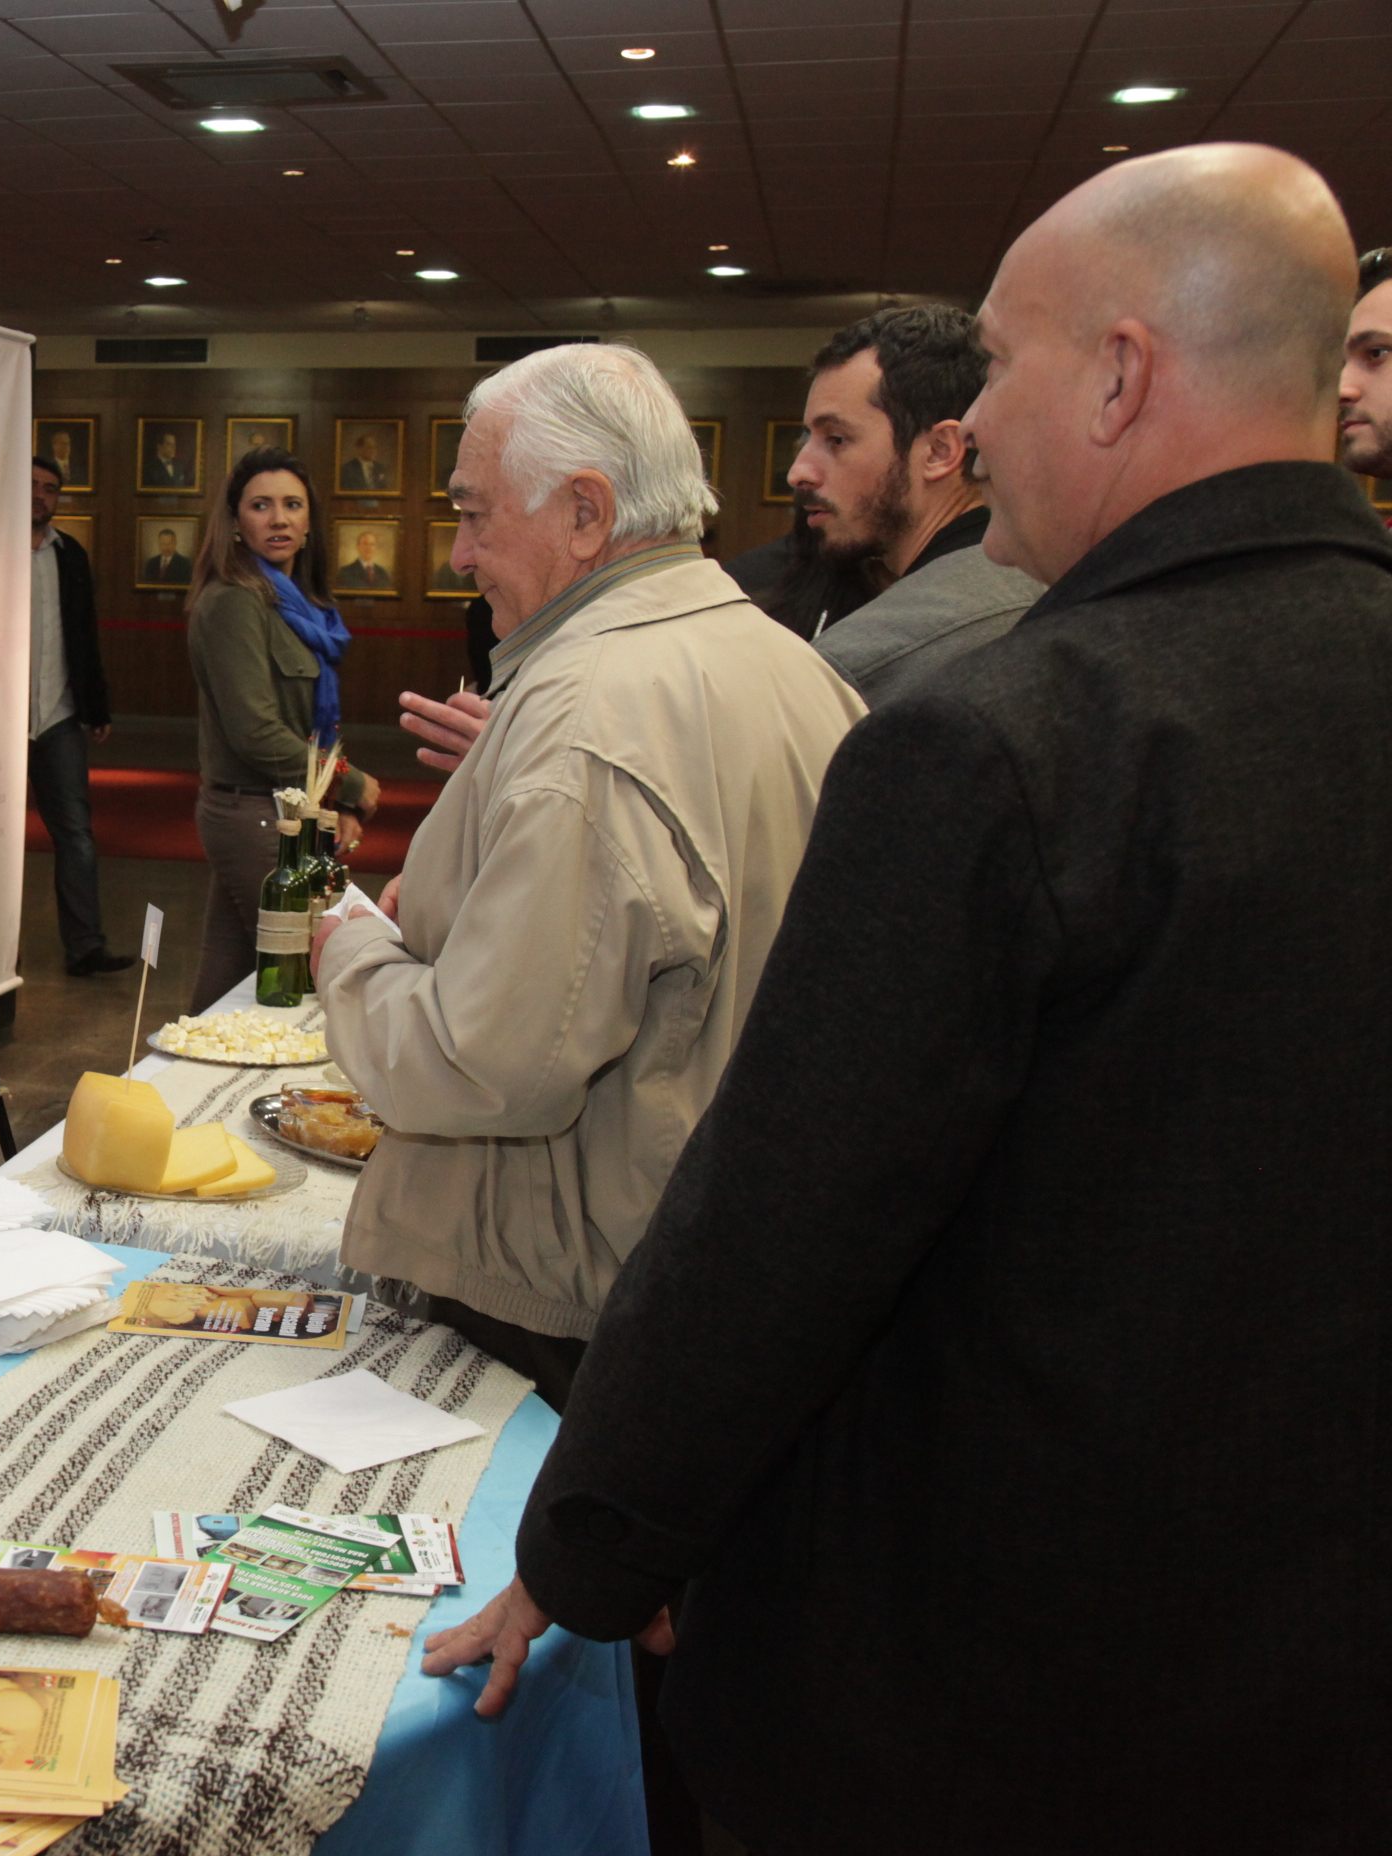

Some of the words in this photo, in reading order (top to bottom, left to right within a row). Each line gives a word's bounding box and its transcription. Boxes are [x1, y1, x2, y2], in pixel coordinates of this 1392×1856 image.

[253, 1307, 278, 1332] Serrano
[279, 1306, 305, 1337] Artesanal
[306, 1313, 329, 1334] Queijo
[313, 1540, 347, 1552] MAIORES
[311, 1548, 364, 1566] AGRICULTURA
[347, 1549, 368, 1557] PARA
[313, 1556, 350, 1568] PROCURE
[233, 1569, 278, 1583] PRODUTOS
[250, 1581, 289, 1593] AGREGAR
[291, 1591, 314, 1599] QUER
